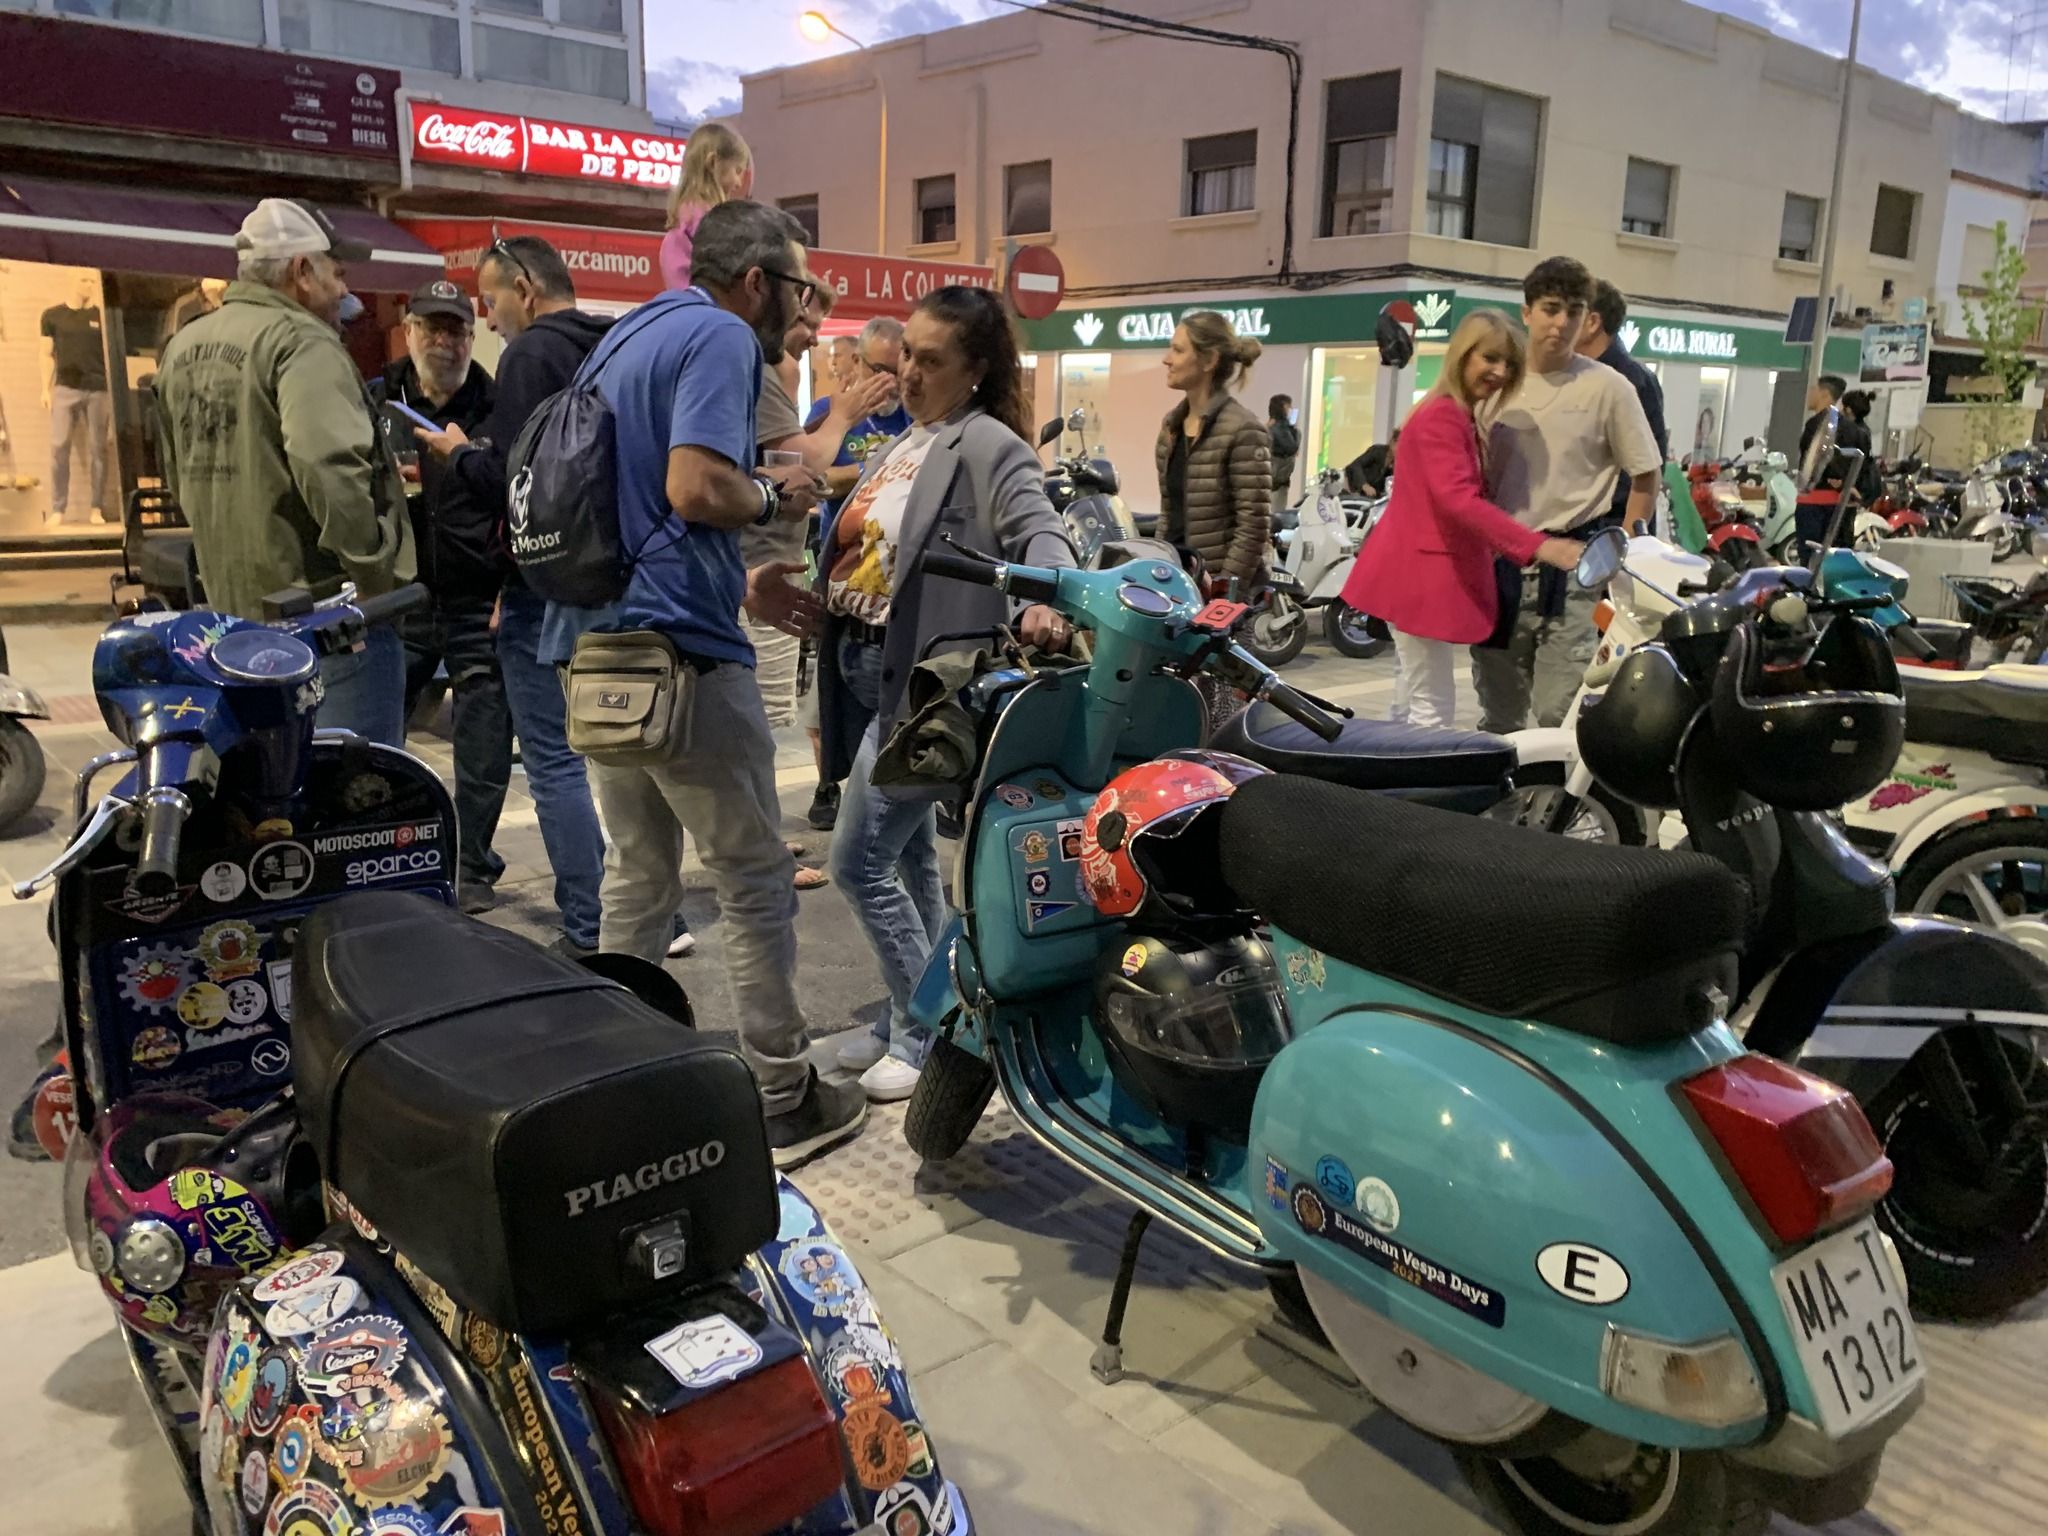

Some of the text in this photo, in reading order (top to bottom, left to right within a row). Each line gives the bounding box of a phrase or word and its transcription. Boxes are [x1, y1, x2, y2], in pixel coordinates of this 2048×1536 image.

[352, 113, 384, 126] REPLAY
[352, 129, 387, 144] DIESEL
[418, 114, 516, 159] Coca-Cola
[530, 123, 588, 151] BAR
[592, 132, 628, 156] LA
[581, 154, 616, 177] DE
[866, 268, 893, 299] LA
[1118, 311, 1176, 342] CAJA
[1648, 326, 1738, 357] CAJA RURAL
[518, 531, 561, 553] Motor
[313, 823, 440, 854] MOTOSCOOT NET
[346, 850, 441, 884] sparco
[564, 1140, 726, 1218] PIAGGIO
[240, 1200, 276, 1247] HELMETS
[1334, 1211, 1400, 1260] European
[1401, 1247, 1447, 1285] Vespa
[1450, 1273, 1490, 1306] Days
[1392, 1261, 1422, 1286] 2022
[1563, 1249, 1600, 1297] E
[1786, 1229, 1886, 1342] MA-T
[1822, 1306, 1917, 1415] 1312
[509, 1362, 562, 1496] European
[397, 1461, 434, 1482] ELCHE
[535, 1490, 562, 1536] 202
